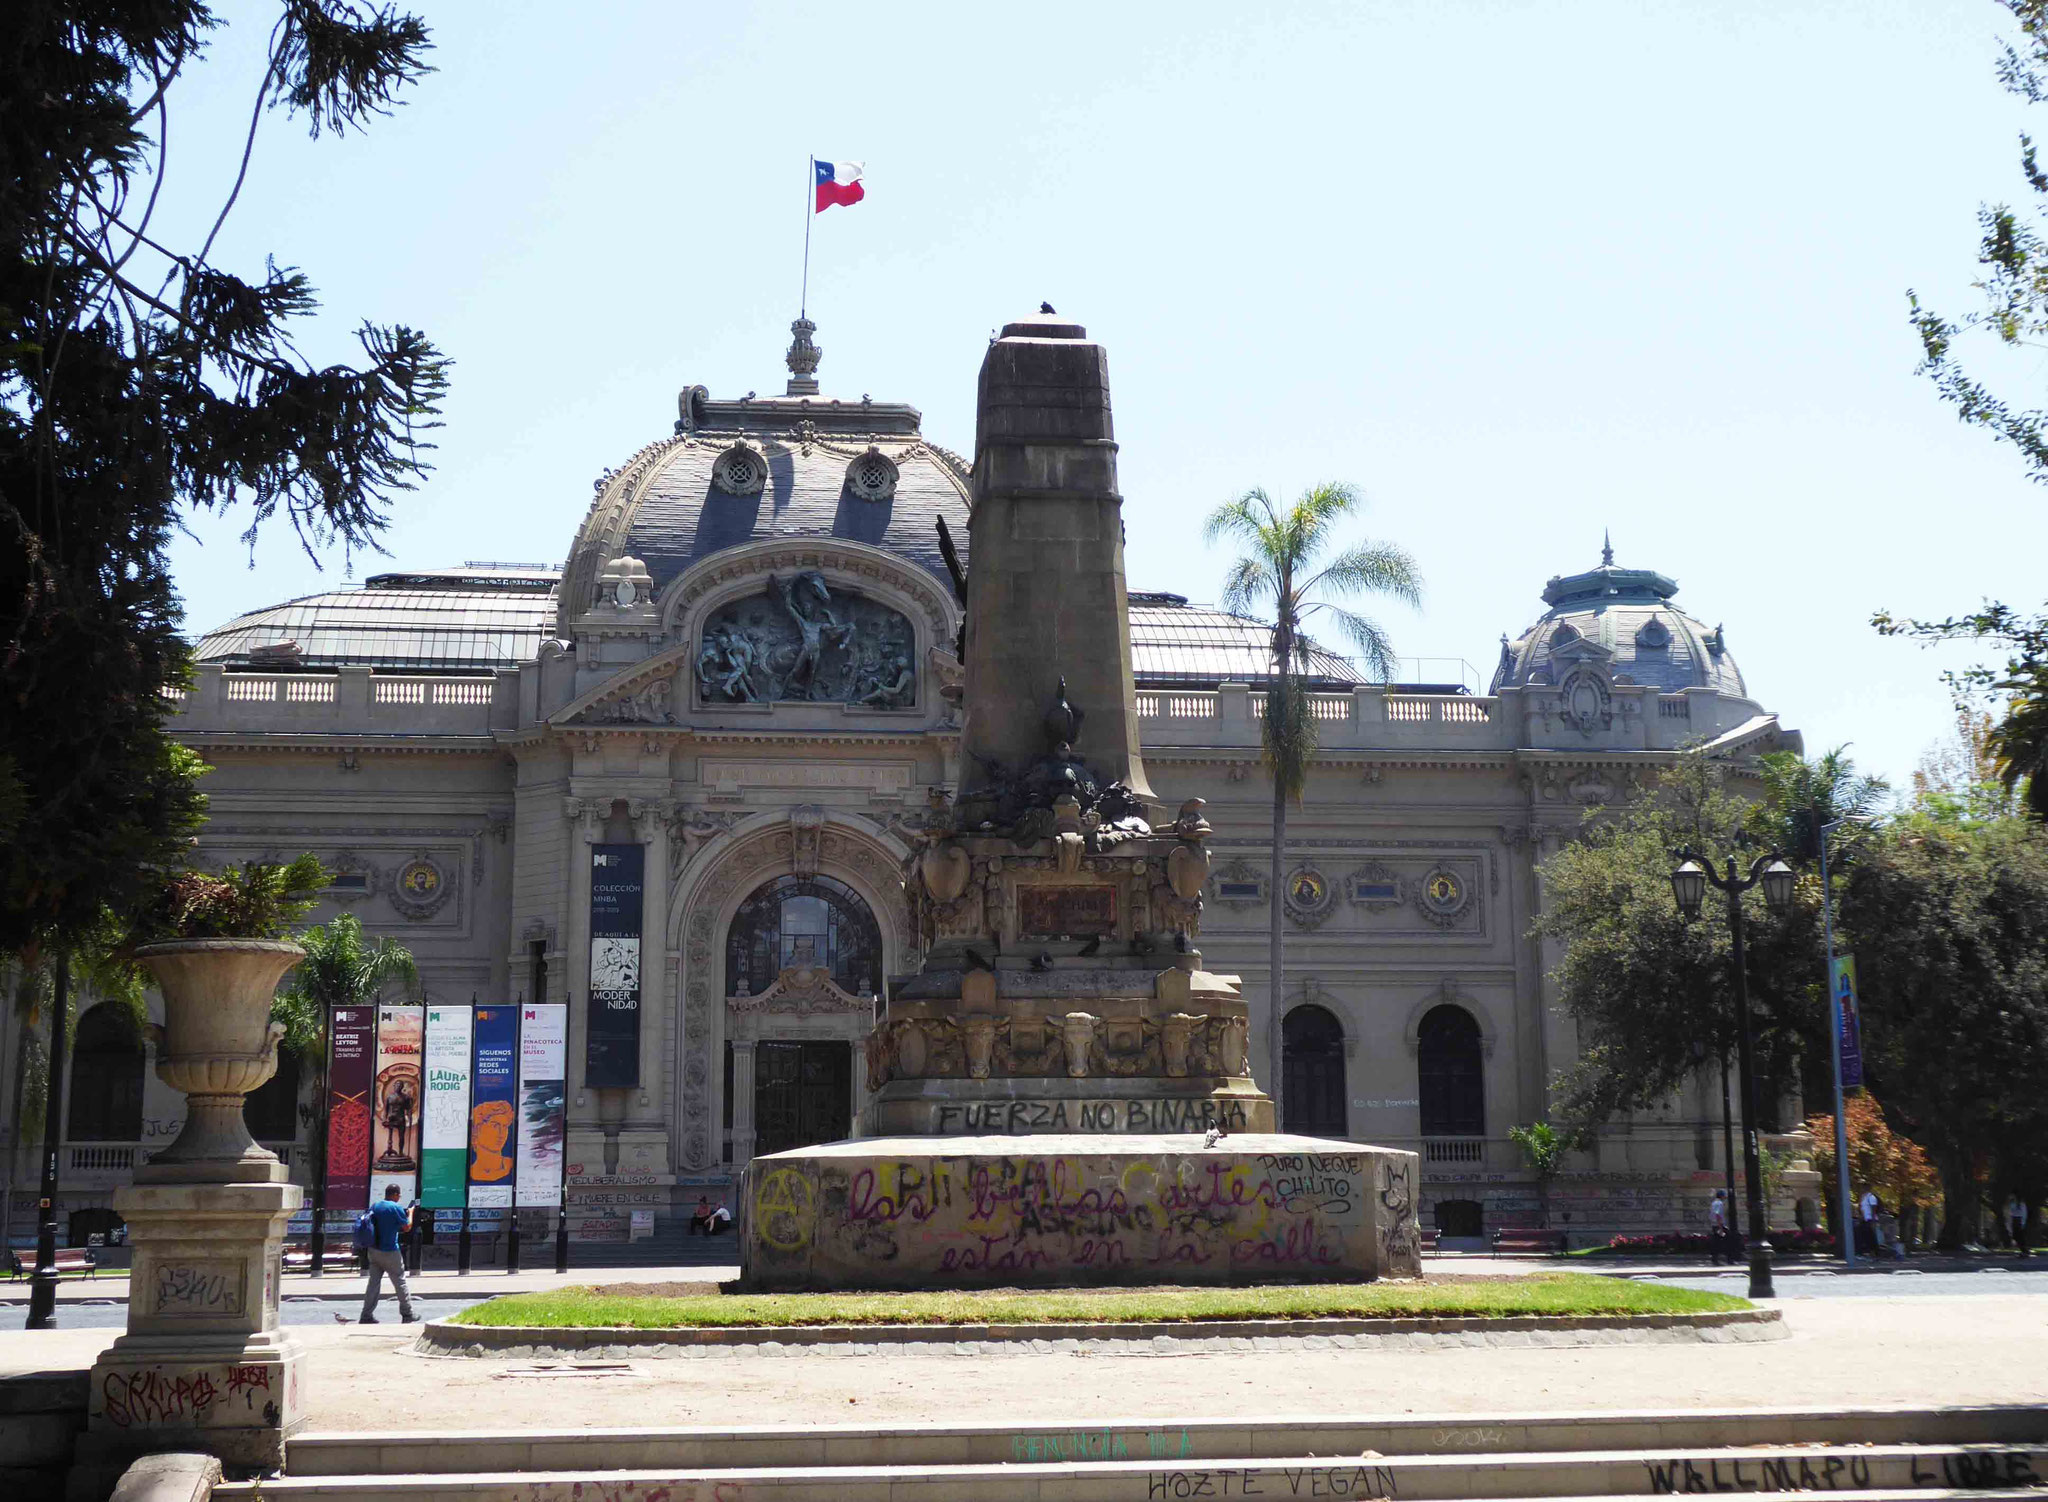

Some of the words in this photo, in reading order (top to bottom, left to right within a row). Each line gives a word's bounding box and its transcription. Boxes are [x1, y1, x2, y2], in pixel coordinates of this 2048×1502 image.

[593, 883, 641, 892] COLECCIÓN
[593, 895, 617, 903] MNBA
[592, 990, 631, 1000] MODER
[607, 1000, 637, 1010] NIDAD
[430, 1070, 467, 1081] LAURA
[430, 1082, 460, 1091] RODIG
[938, 1101, 1069, 1132] FUERZA
[1080, 1102, 1115, 1131] NO
[1257, 1155, 1303, 1180] PURO
[1307, 1156, 1362, 1177] NEQUE
[616, 1192, 631, 1203] EN
[1644, 1455, 1871, 1494] WALLMAPU
[1910, 1452, 2041, 1490] LIBRE
[1284, 1465, 1398, 1497] VEGAN
